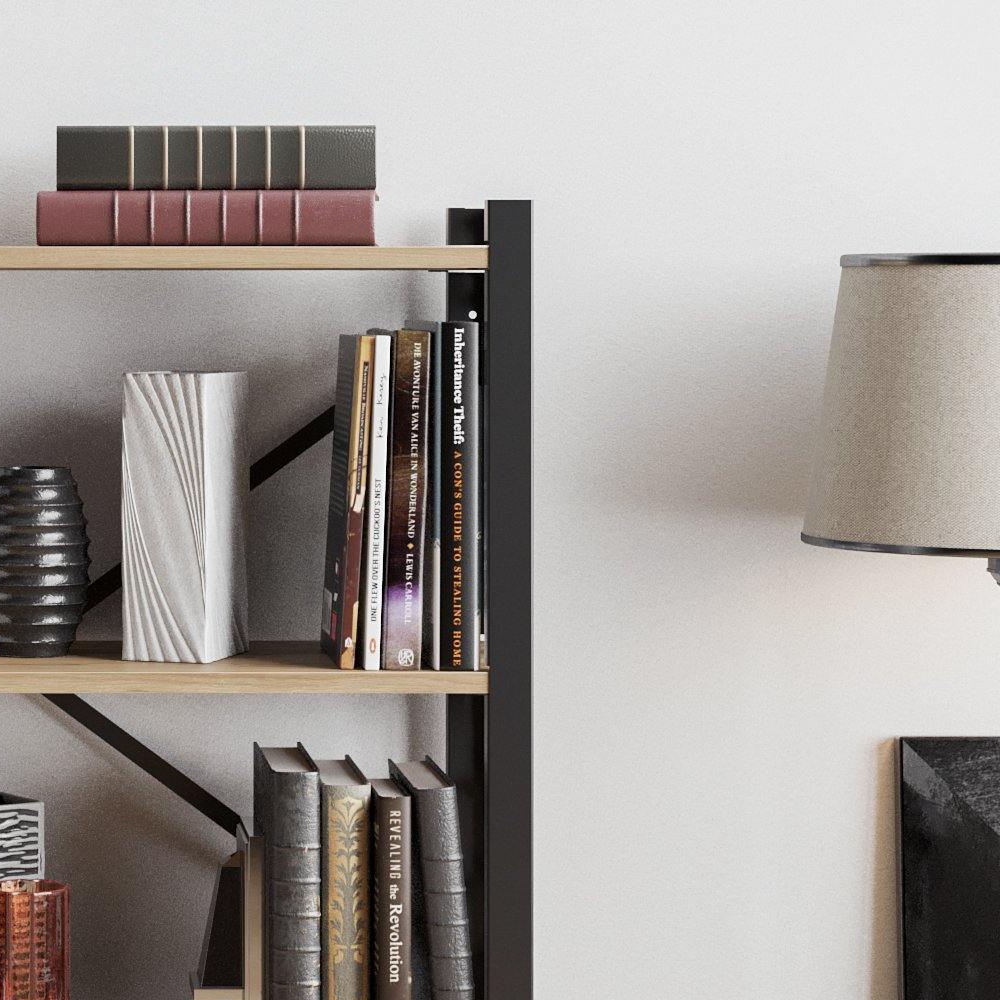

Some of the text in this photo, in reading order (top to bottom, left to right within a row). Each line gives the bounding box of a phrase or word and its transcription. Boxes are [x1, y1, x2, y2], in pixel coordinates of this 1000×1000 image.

[373, 500, 381, 540] CUCKOO'S
[374, 478, 382, 498] NEST
[404, 341, 422, 625] DIE AVONTURE VAN ALICE IN WONDERLAND LEWIS CARROLL
[452, 327, 466, 667] Inheritance Theif: A CON'S GUIDE TO STEALING HOME
[371, 582, 379, 604] FLEW
[388, 810, 403, 983] REVEALING the Revolution
